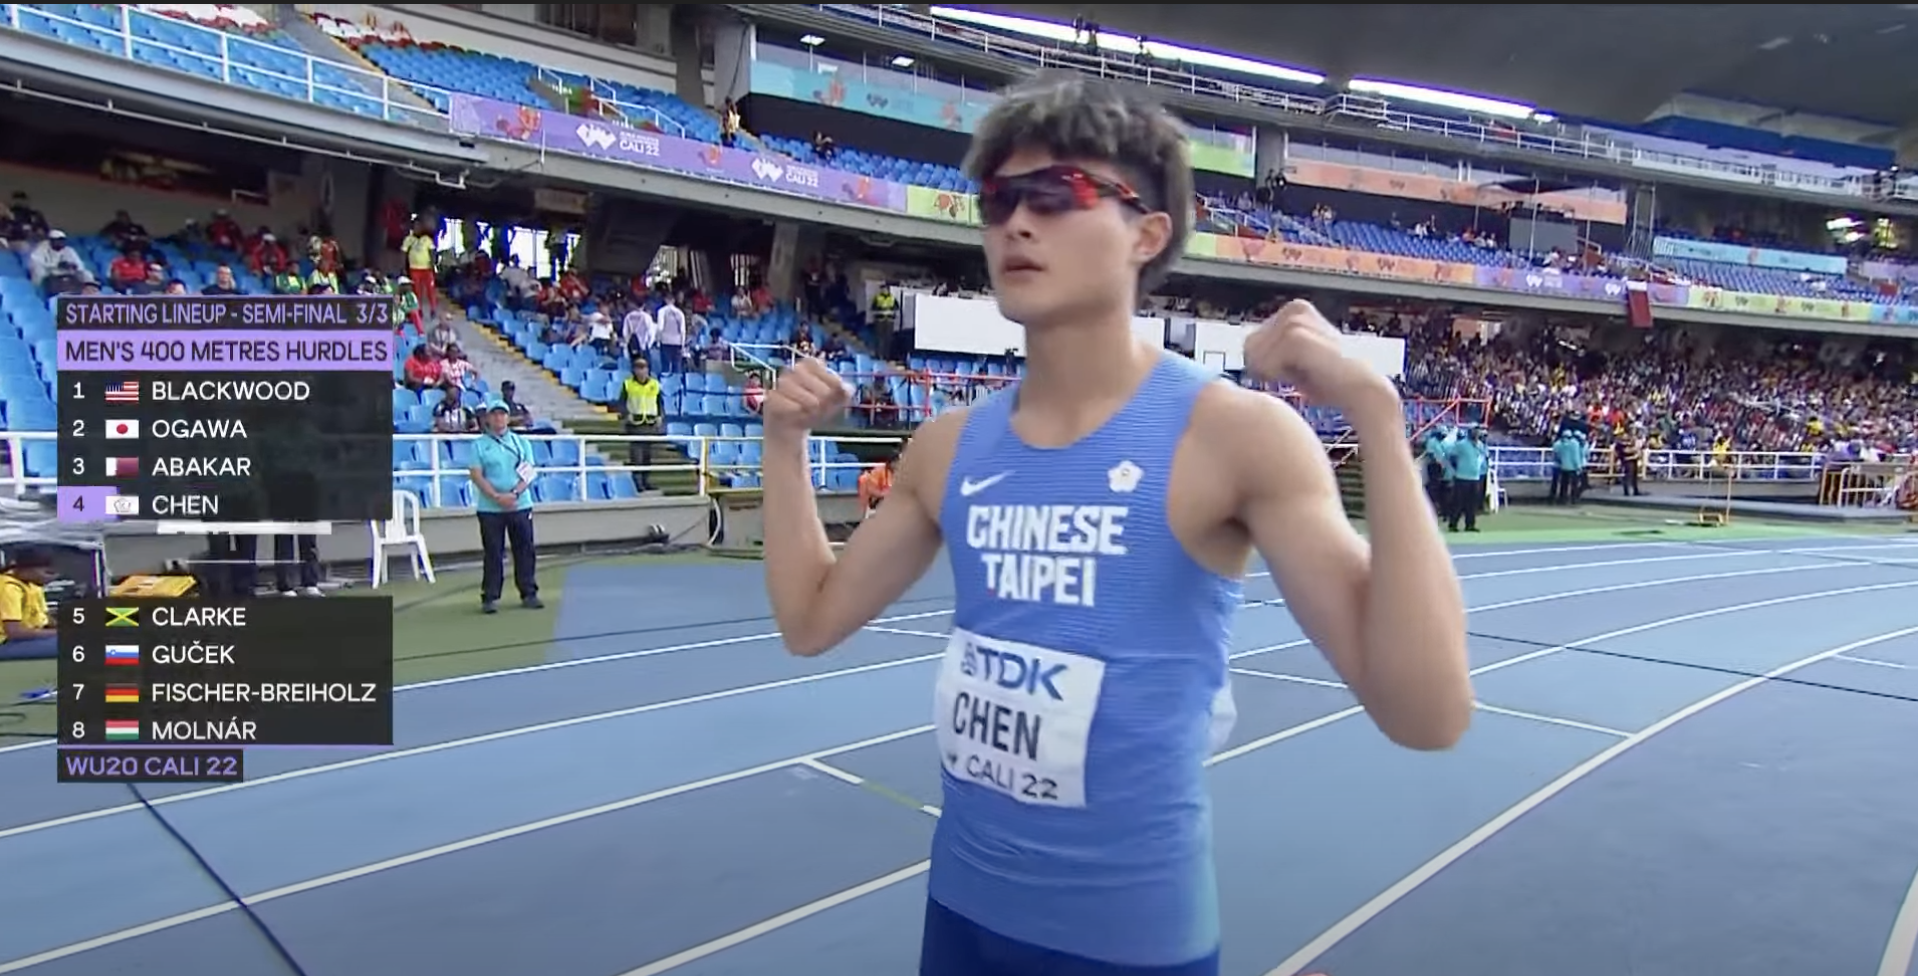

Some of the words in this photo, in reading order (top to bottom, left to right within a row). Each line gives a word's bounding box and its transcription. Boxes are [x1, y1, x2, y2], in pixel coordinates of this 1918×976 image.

[620, 139, 644, 153] CALI
[646, 144, 660, 156] 22
[785, 172, 806, 185] CALI
[966, 504, 1129, 555] CHINESE
[981, 553, 1097, 607] TAIPEI
[976, 645, 1069, 702] TDK
[953, 691, 1041, 761] CHEN
[966, 754, 1015, 791] CALI
[1021, 773, 1059, 801] 22
